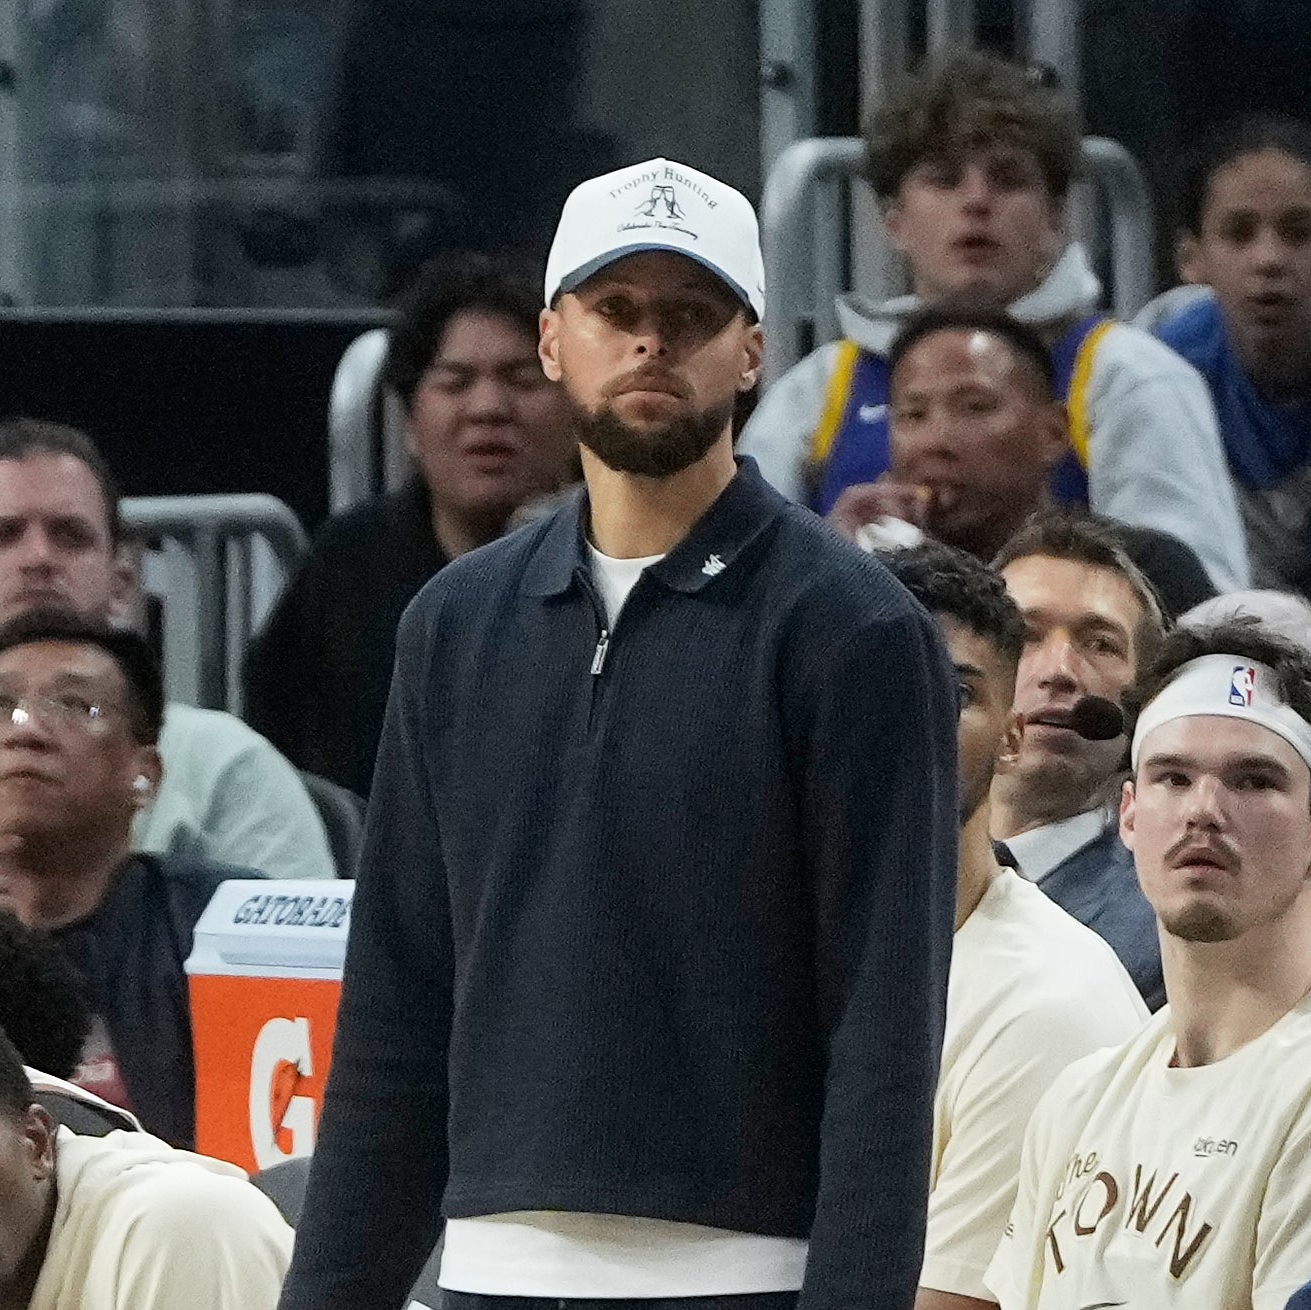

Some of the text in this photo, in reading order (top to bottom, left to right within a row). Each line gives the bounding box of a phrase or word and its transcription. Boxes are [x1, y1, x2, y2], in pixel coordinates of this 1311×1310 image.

[609, 167, 718, 209] Trophy Hunting
[249, 1016, 315, 1171] G
[1046, 1163, 1212, 1279] TOWN
